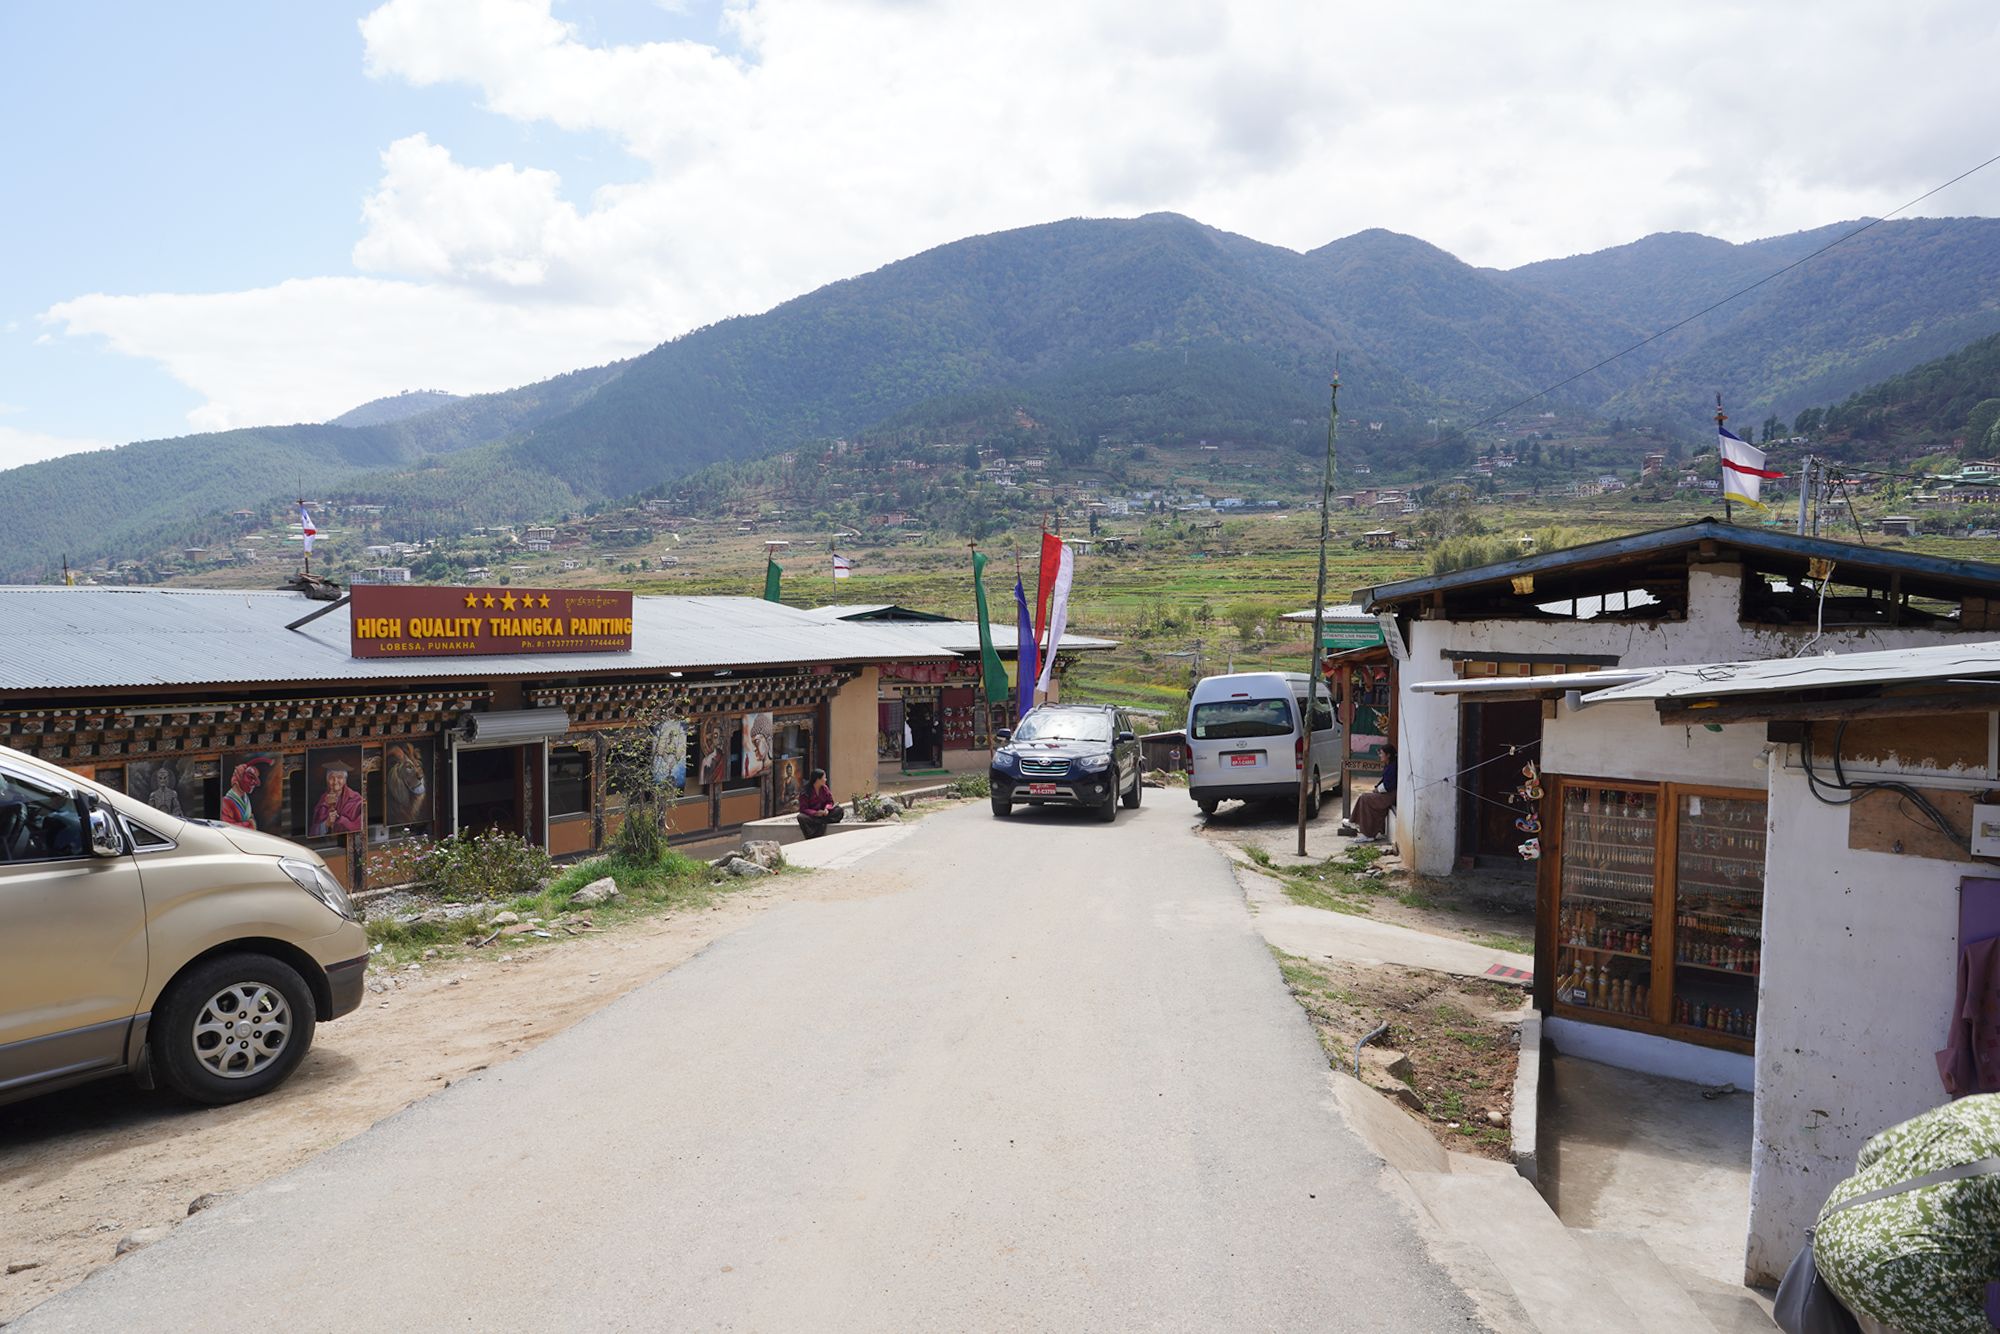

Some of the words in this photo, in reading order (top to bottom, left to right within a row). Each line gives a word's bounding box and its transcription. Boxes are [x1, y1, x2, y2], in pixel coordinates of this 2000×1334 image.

[356, 617, 402, 639] HIGH
[409, 617, 482, 638] QUALITY
[489, 617, 564, 637] THANGKA
[570, 617, 633, 636] PAINTING
[380, 642, 426, 652] LOBESA,
[428, 641, 476, 650] PUNAKHA
